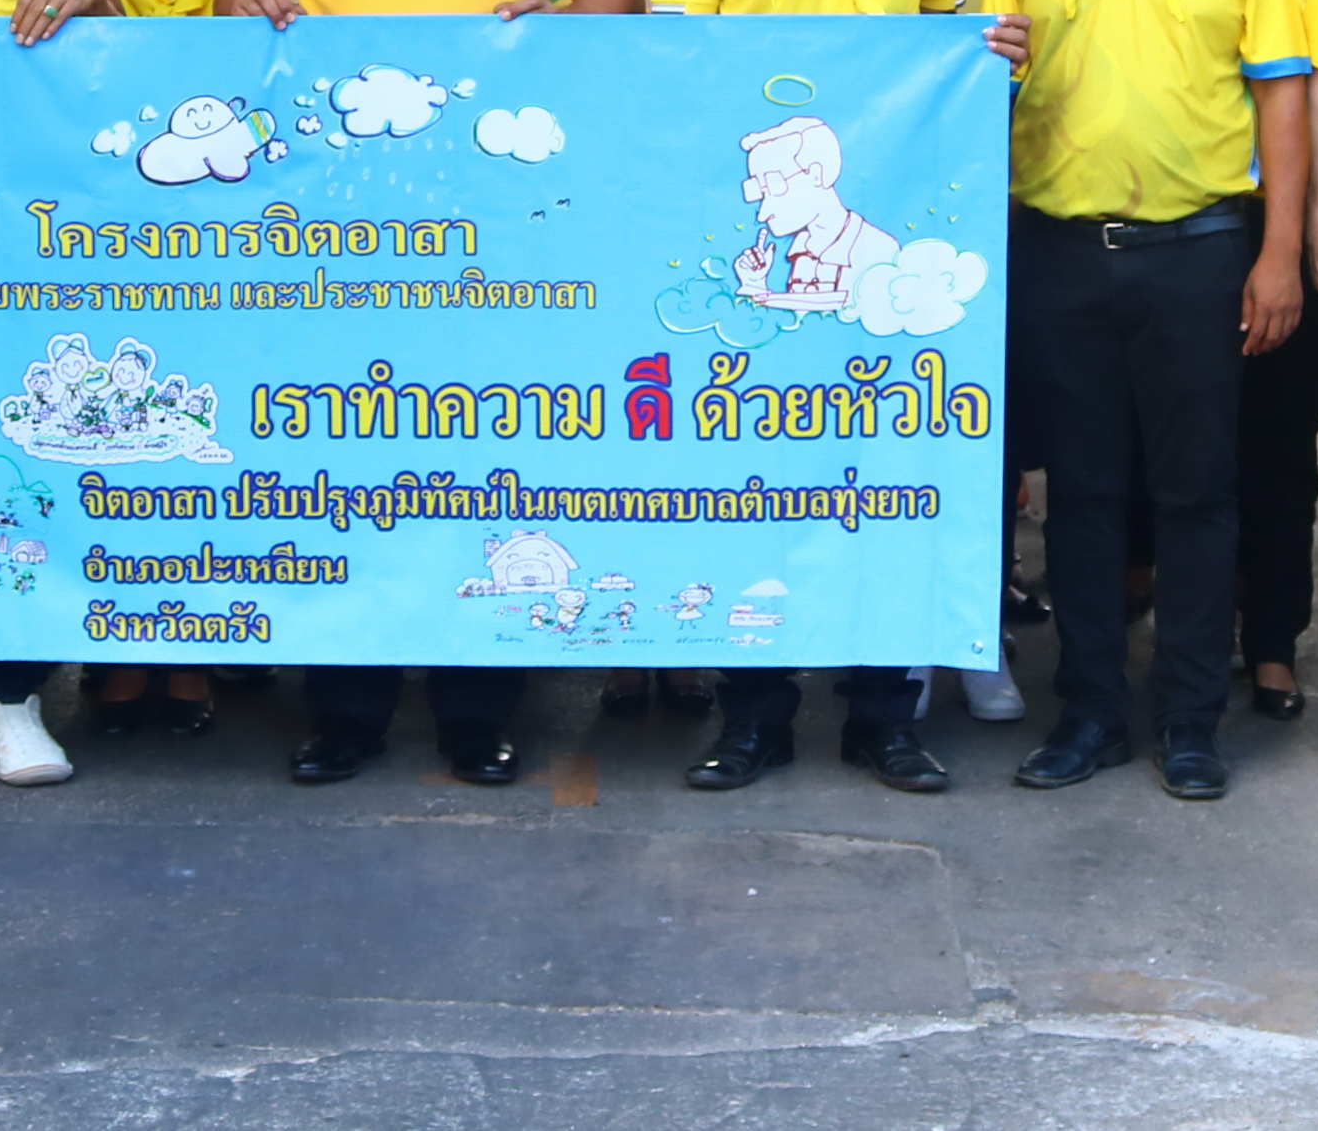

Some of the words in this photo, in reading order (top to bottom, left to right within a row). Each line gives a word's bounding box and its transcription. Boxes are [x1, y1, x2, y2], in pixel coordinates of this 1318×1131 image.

[26, 200, 476, 258] โครงการจิตอาสา
[231, 267, 594, 309] และประชาชนจิตอาสา
[251, 360, 604, 440] เราทำความ
[624, 353, 672, 440] ดี
[692, 349, 990, 440] ด้วยหัวใจ
[78, 471, 216, 520] จิตอาสา
[222, 467, 939, 532] ปรับปรุงภูมิทัศน์ในเขตเทศบาลตำบลทุ่งยาว
[82, 541, 348, 584] อำเภอปะเหลียน
[84, 600, 270, 642] จังหวัดตรัง
